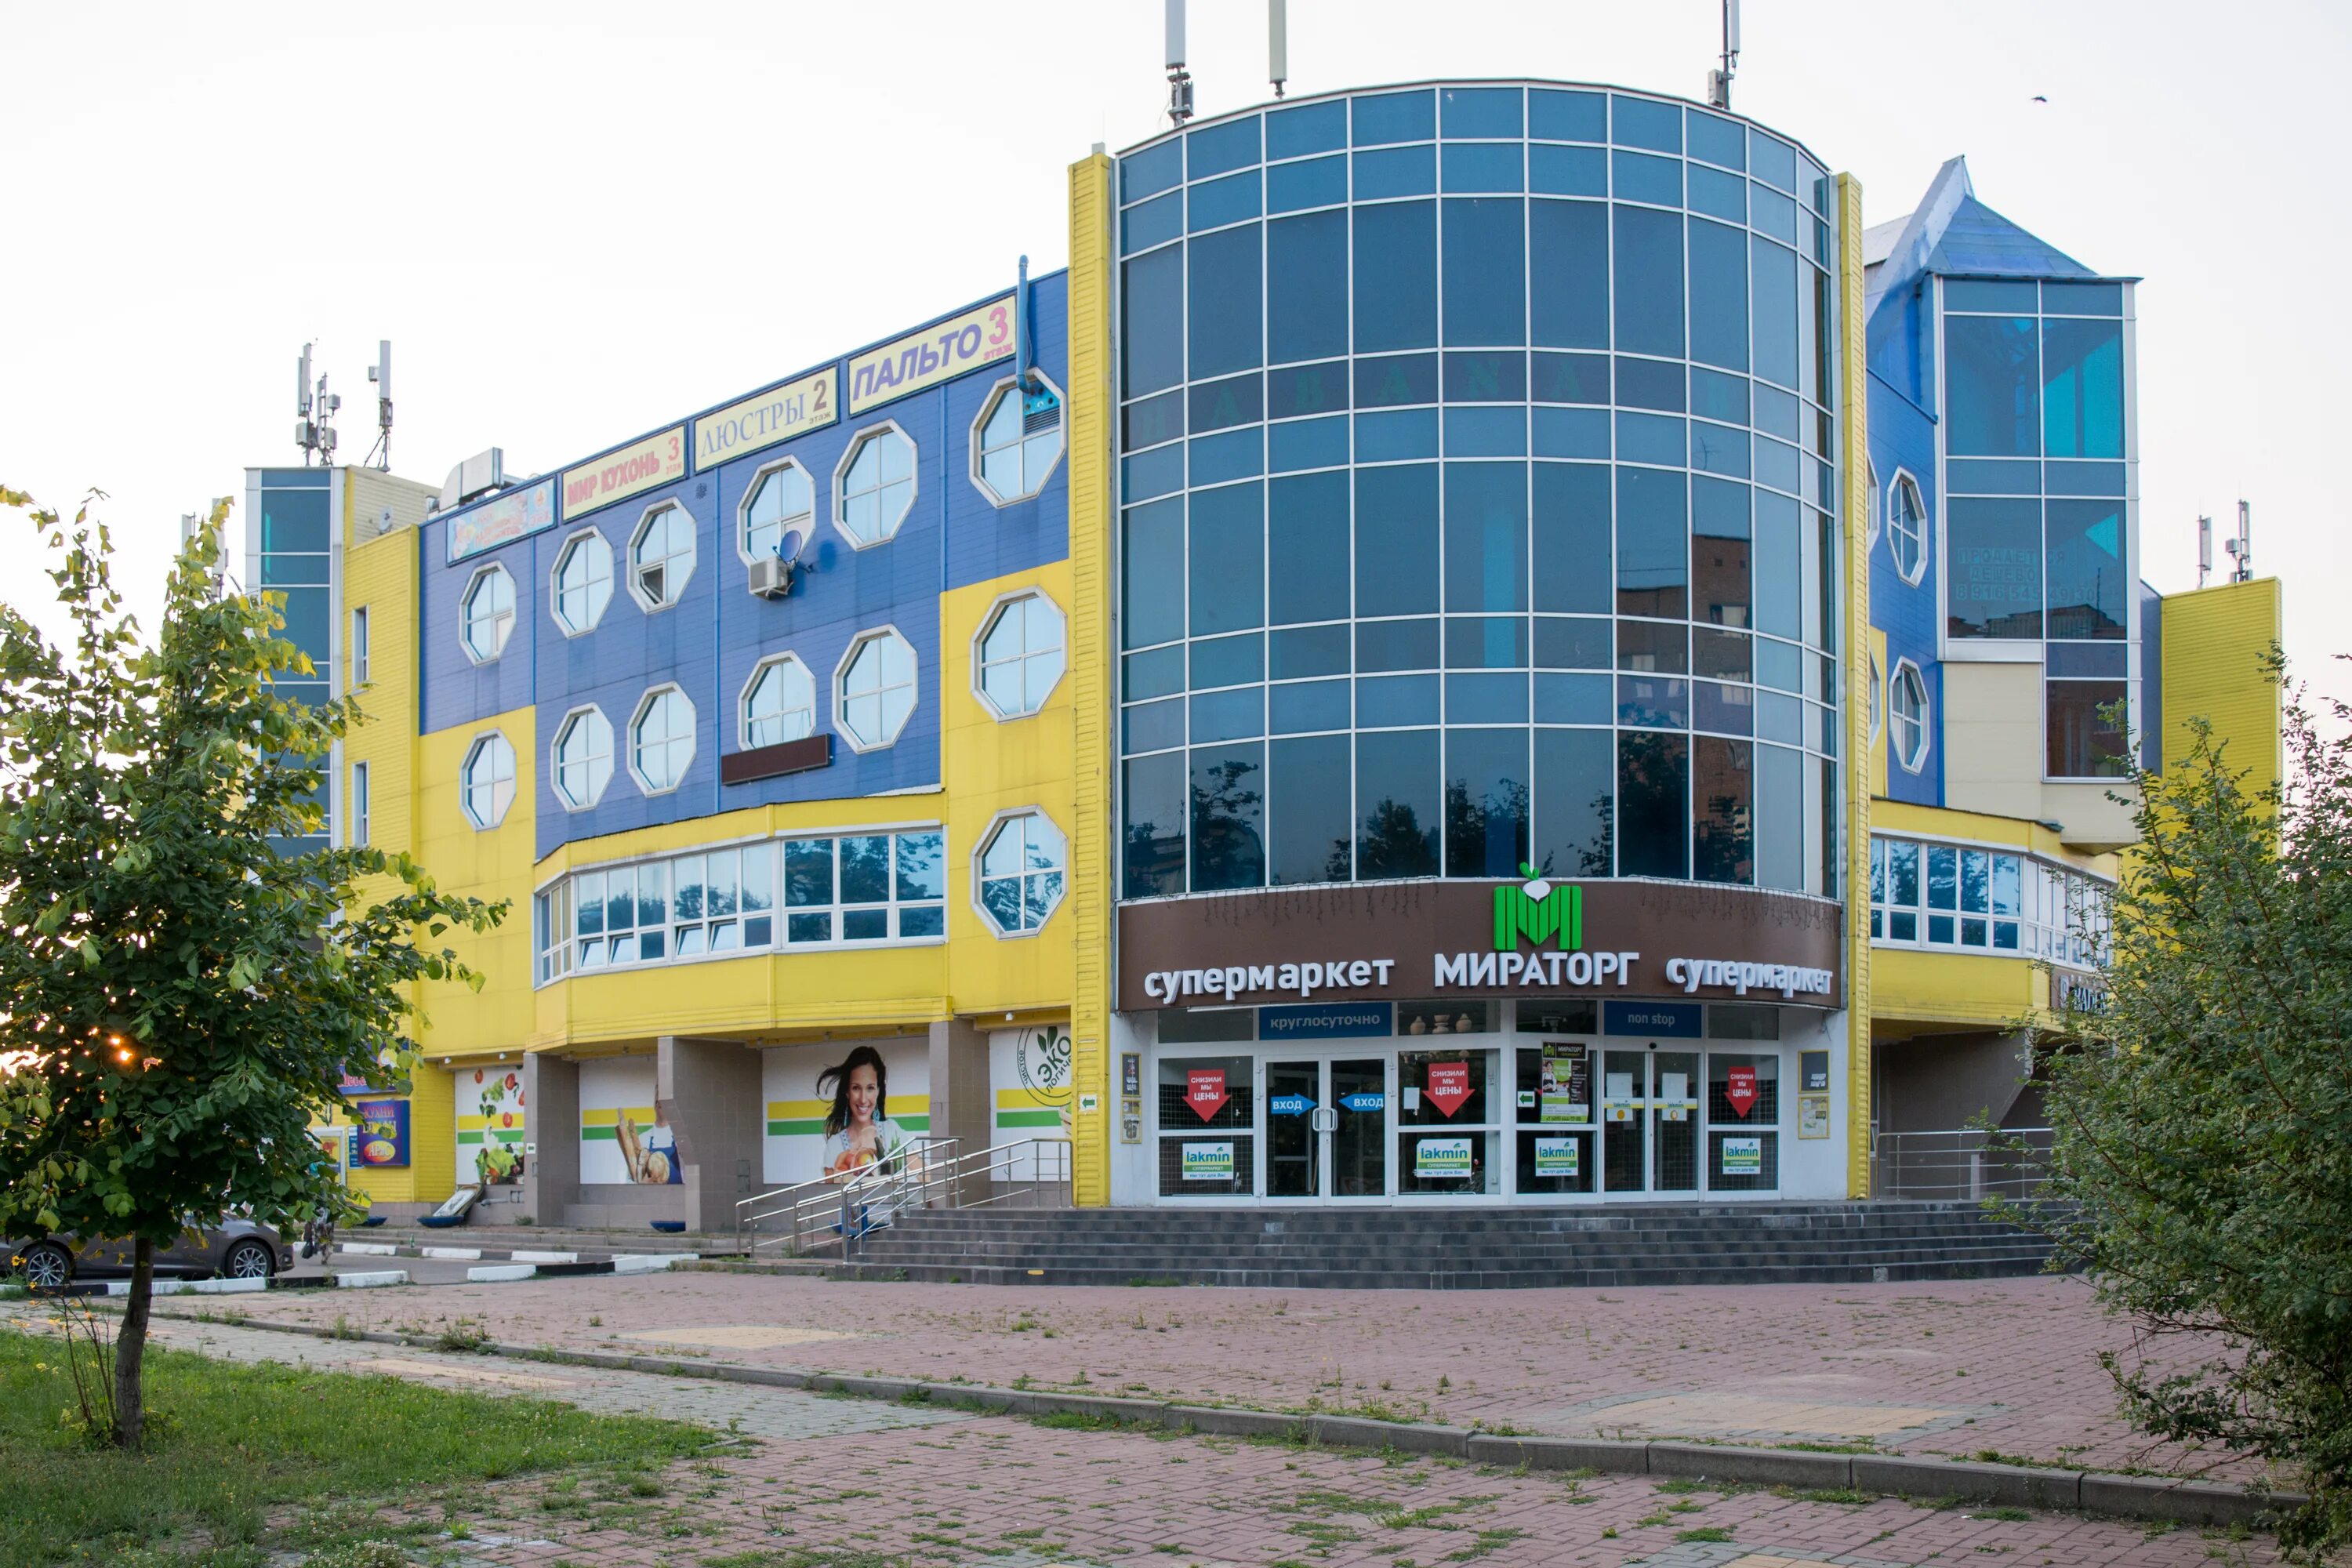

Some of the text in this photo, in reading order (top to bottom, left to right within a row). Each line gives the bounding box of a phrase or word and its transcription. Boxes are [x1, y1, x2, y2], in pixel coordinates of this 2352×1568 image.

[853, 306, 1008, 401] ПАЛЬТО 3
[983, 343, 1013, 361] этаж
[700, 379, 827, 457] ЛЮСТРЫ 2
[808, 411, 832, 425] этаж
[568, 436, 680, 507] МИР КУХОНЬ 3
[1958, 550, 2066, 564] ПРОДАЕТСЯ
[1971, 566, 2036, 582] ДЕШЕВО
[1957, 585, 1967, 601] 8
[1972, 586, 2003, 601] 916
[2076, 588, 2096, 601] 30
[1145, 952, 1833, 1004] супермаркет МИРАТОРГ супермаркет
[1270, 1014, 1380, 1030] круглосуточно
[1628, 1012, 1675, 1027] non stop
[1037, 1036, 1071, 1083] ЭКО
[1194, 1092, 1219, 1102] ЦЕНЫ
[1435, 1086, 1461, 1096] ЦЕНЫ
[1733, 1088, 1751, 1098] ЦЕНЫ
[1272, 1100, 1302, 1110] ВХОД
[1354, 1098, 1384, 1108] ВХОД
[364, 1106, 394, 1118] КУХНИ
[1186, 1149, 1230, 1162] lakmin
[1421, 1145, 1468, 1159] lakmin
[1539, 1144, 1575, 1158] lakmin
[1726, 1143, 1758, 1157] lakmin
